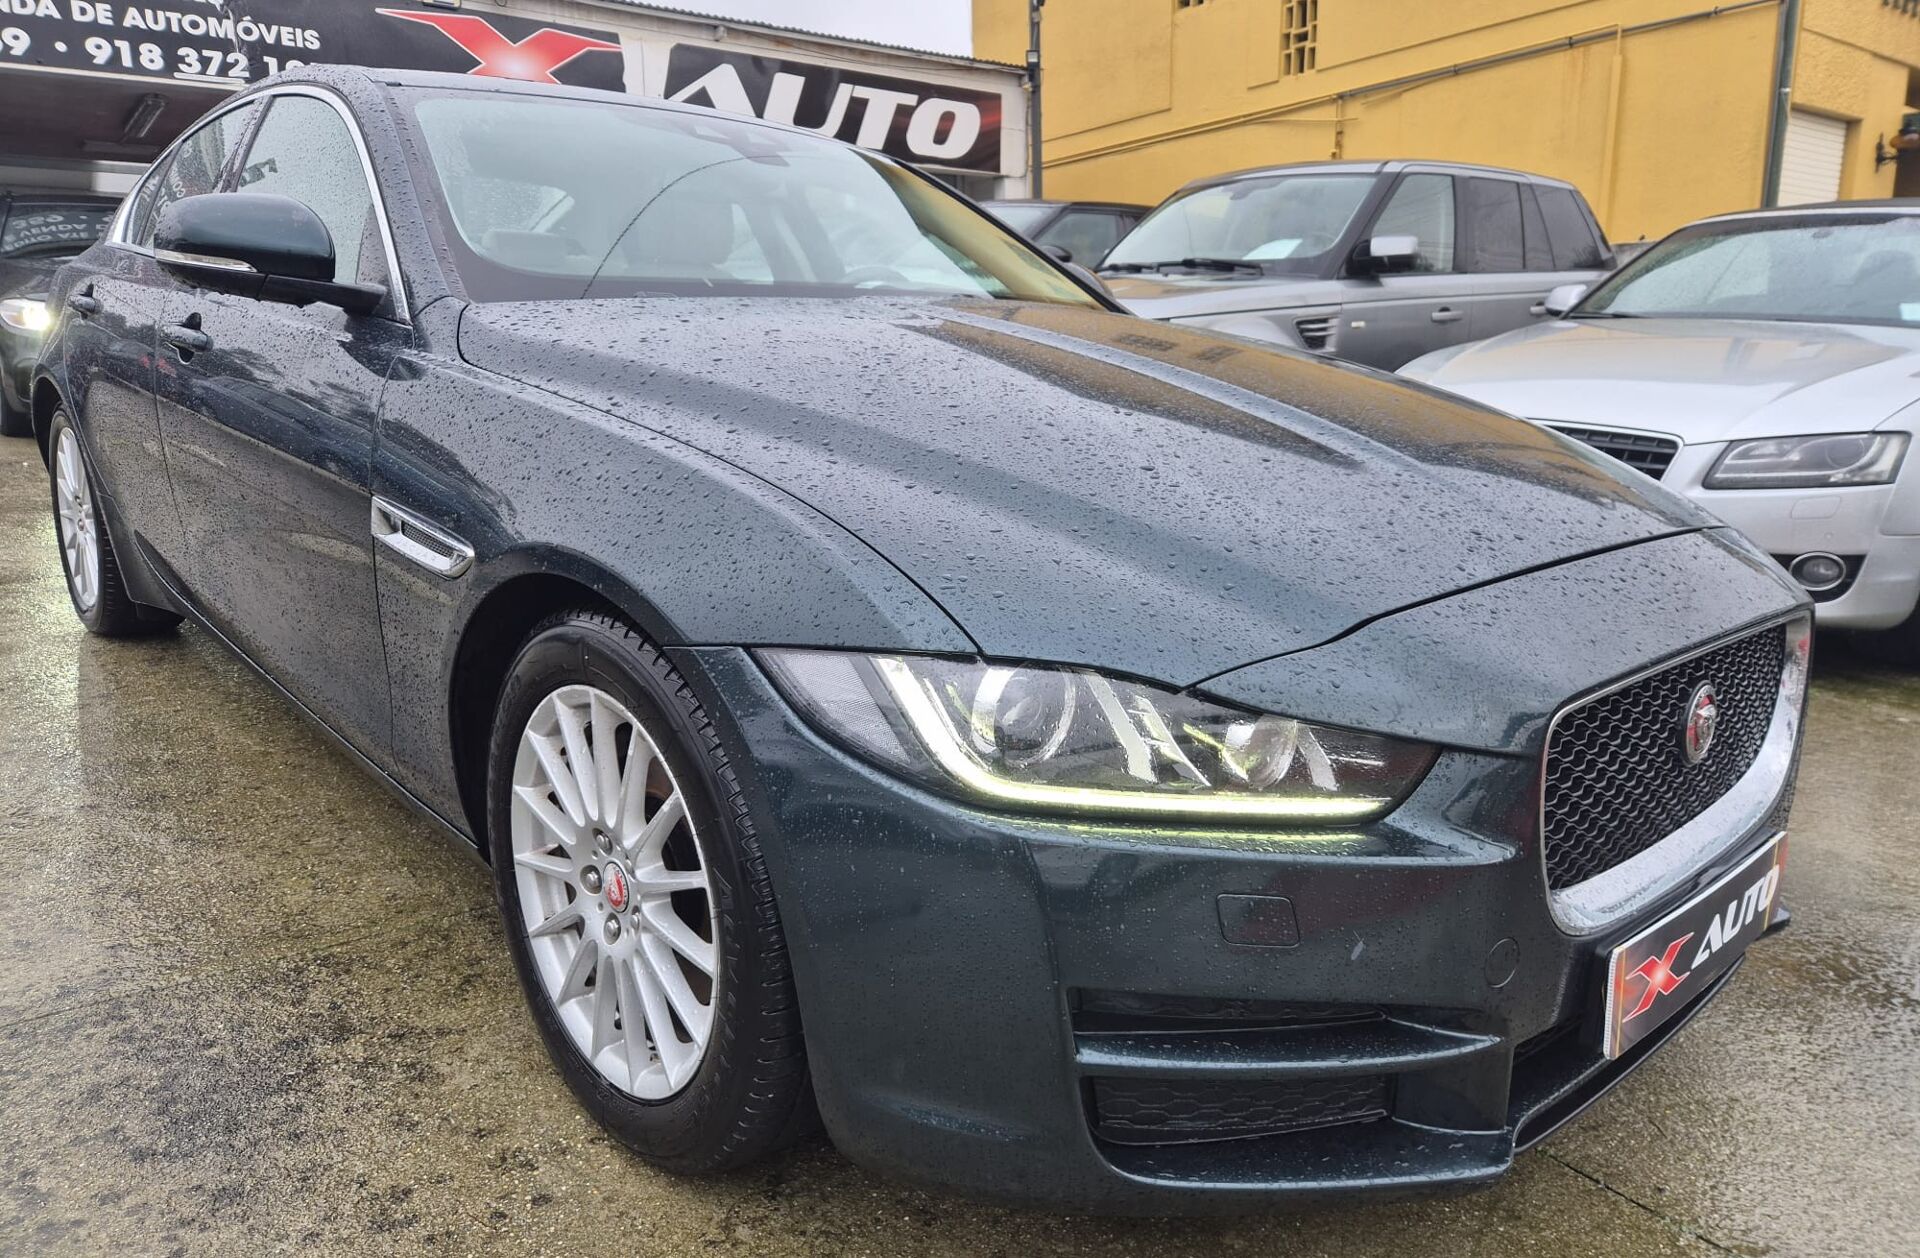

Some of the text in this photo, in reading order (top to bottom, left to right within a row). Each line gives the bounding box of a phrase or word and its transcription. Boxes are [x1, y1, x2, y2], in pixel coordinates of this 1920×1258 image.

[70, 0, 115, 26] DE
[122, 7, 321, 50] AUTOMÓVEIS
[85, 36, 166, 71] 918
[176, 47, 250, 78] 372
[667, 63, 981, 159] AUTO
[1691, 864, 1780, 970] AUTO
